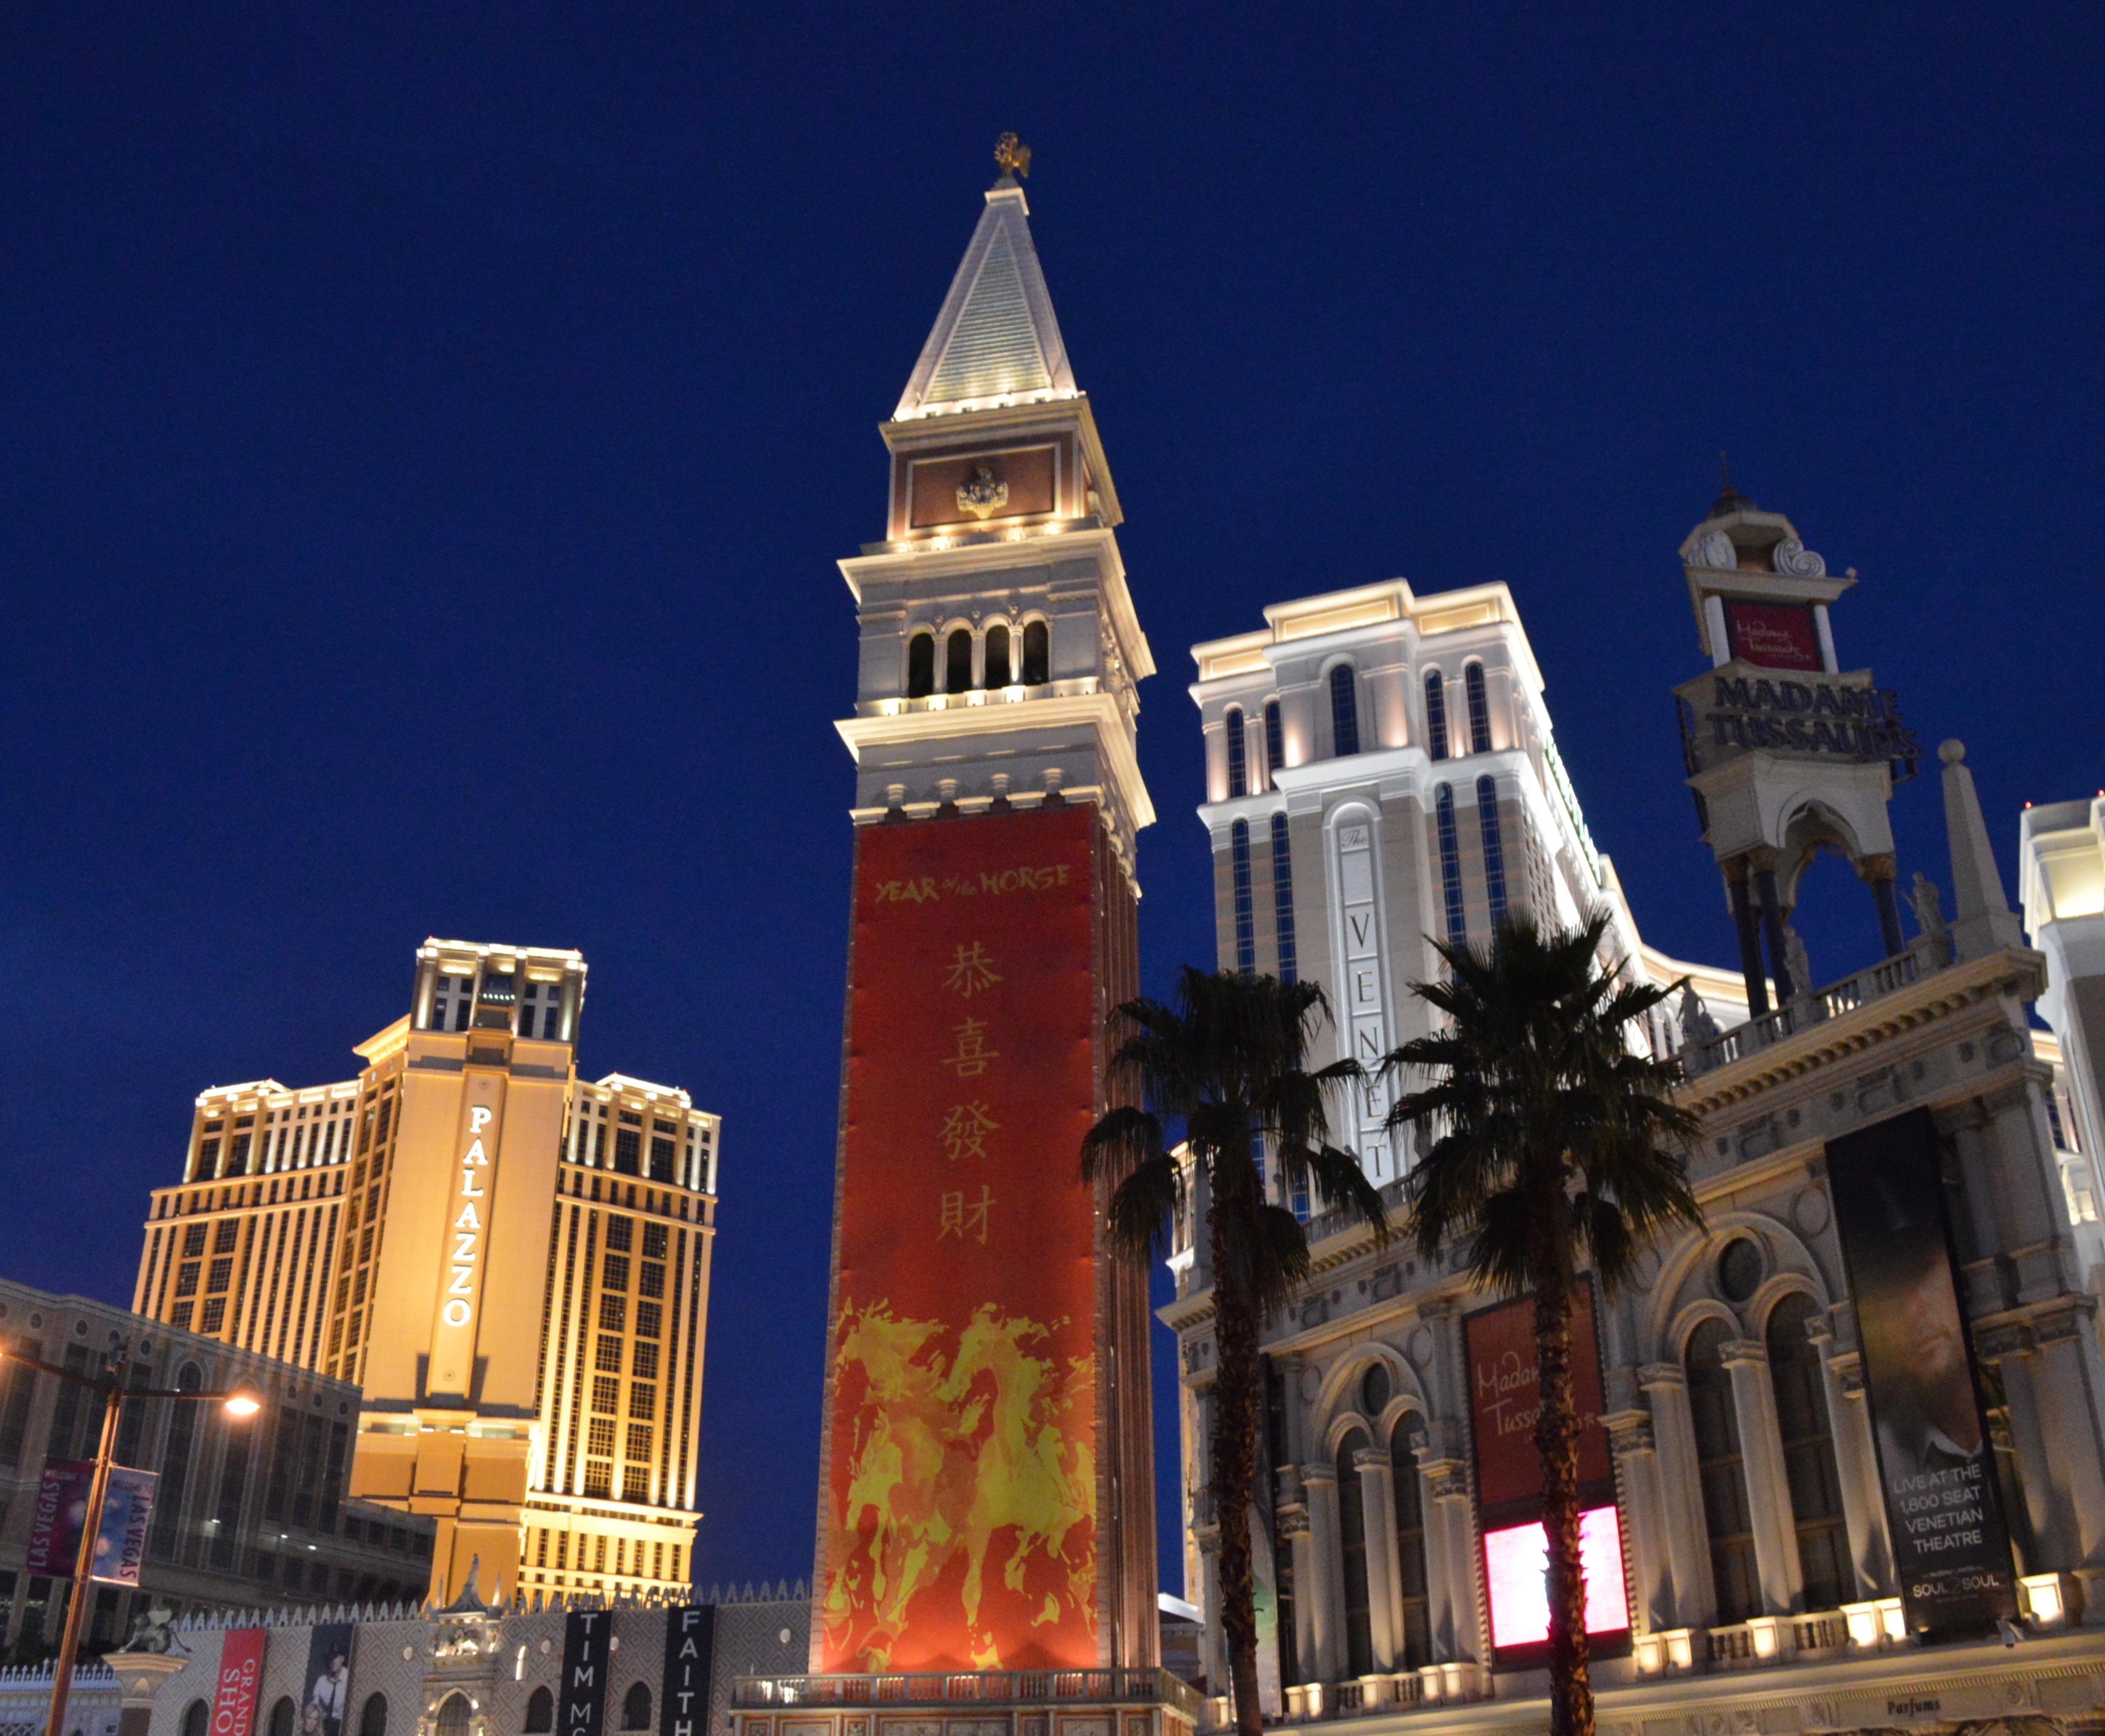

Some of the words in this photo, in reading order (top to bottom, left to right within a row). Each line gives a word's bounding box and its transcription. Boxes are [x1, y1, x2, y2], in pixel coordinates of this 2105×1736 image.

[1715, 676, 1902, 720] MADAME
[1705, 713, 1920, 759] TUSSAUDS
[1342, 829, 1367, 848] The
[875, 877, 940, 905] YEAR
[979, 863, 1072, 895] HORSE
[935, 940, 1004, 1245] 恭喜發財
[443, 1106, 492, 1328] PALAZZO
[1893, 1474, 1927, 1494] LIVE
[1929, 1470, 1947, 1485] AT
[1950, 1463, 1982, 1482] THE
[1900, 1494, 1940, 1514] 1,800
[1942, 1485, 1981, 1506] SEAT
[35, 1482, 59, 1533] VEGAS
[130, 1495, 150, 1524] LAS
[1905, 1507, 1984, 1534] VENETIAN
[28, 1535, 50, 1567] LAS
[119, 1529, 144, 1578] VEGAS
[1913, 1529, 1983, 1554] THEATRE
[573, 1613, 598, 1688] TIM
[675, 1611, 701, 1736] FAITH
[234, 1658, 256, 1736] GRAND
[1887, 1698, 1941, 1717] Parfums
